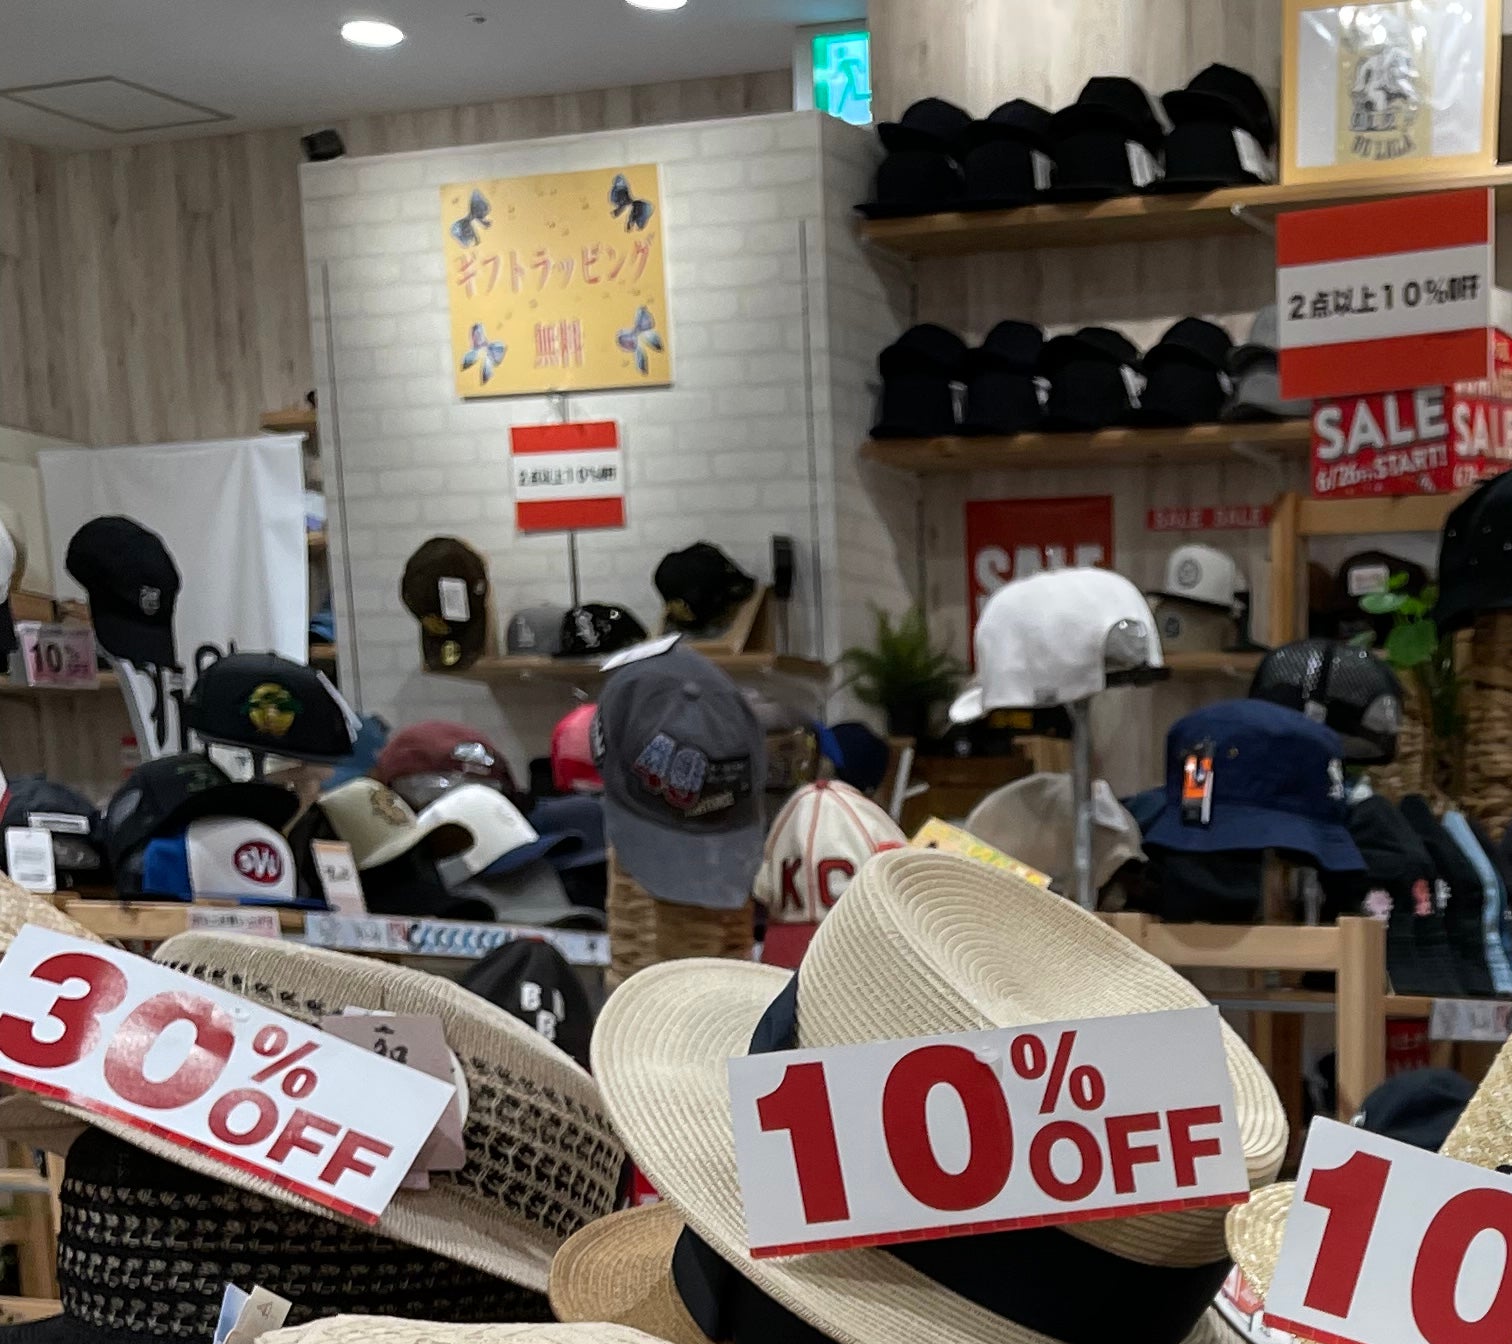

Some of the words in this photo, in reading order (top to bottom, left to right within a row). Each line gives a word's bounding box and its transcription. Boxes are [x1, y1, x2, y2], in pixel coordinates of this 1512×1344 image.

[454, 233, 656, 300] ギフトラッピング
[1314, 386, 1448, 460] SALE
[782, 857, 855, 911] KC
[208, 1088, 394, 1186] OFF
[1029, 1104, 1223, 1202] OFF
